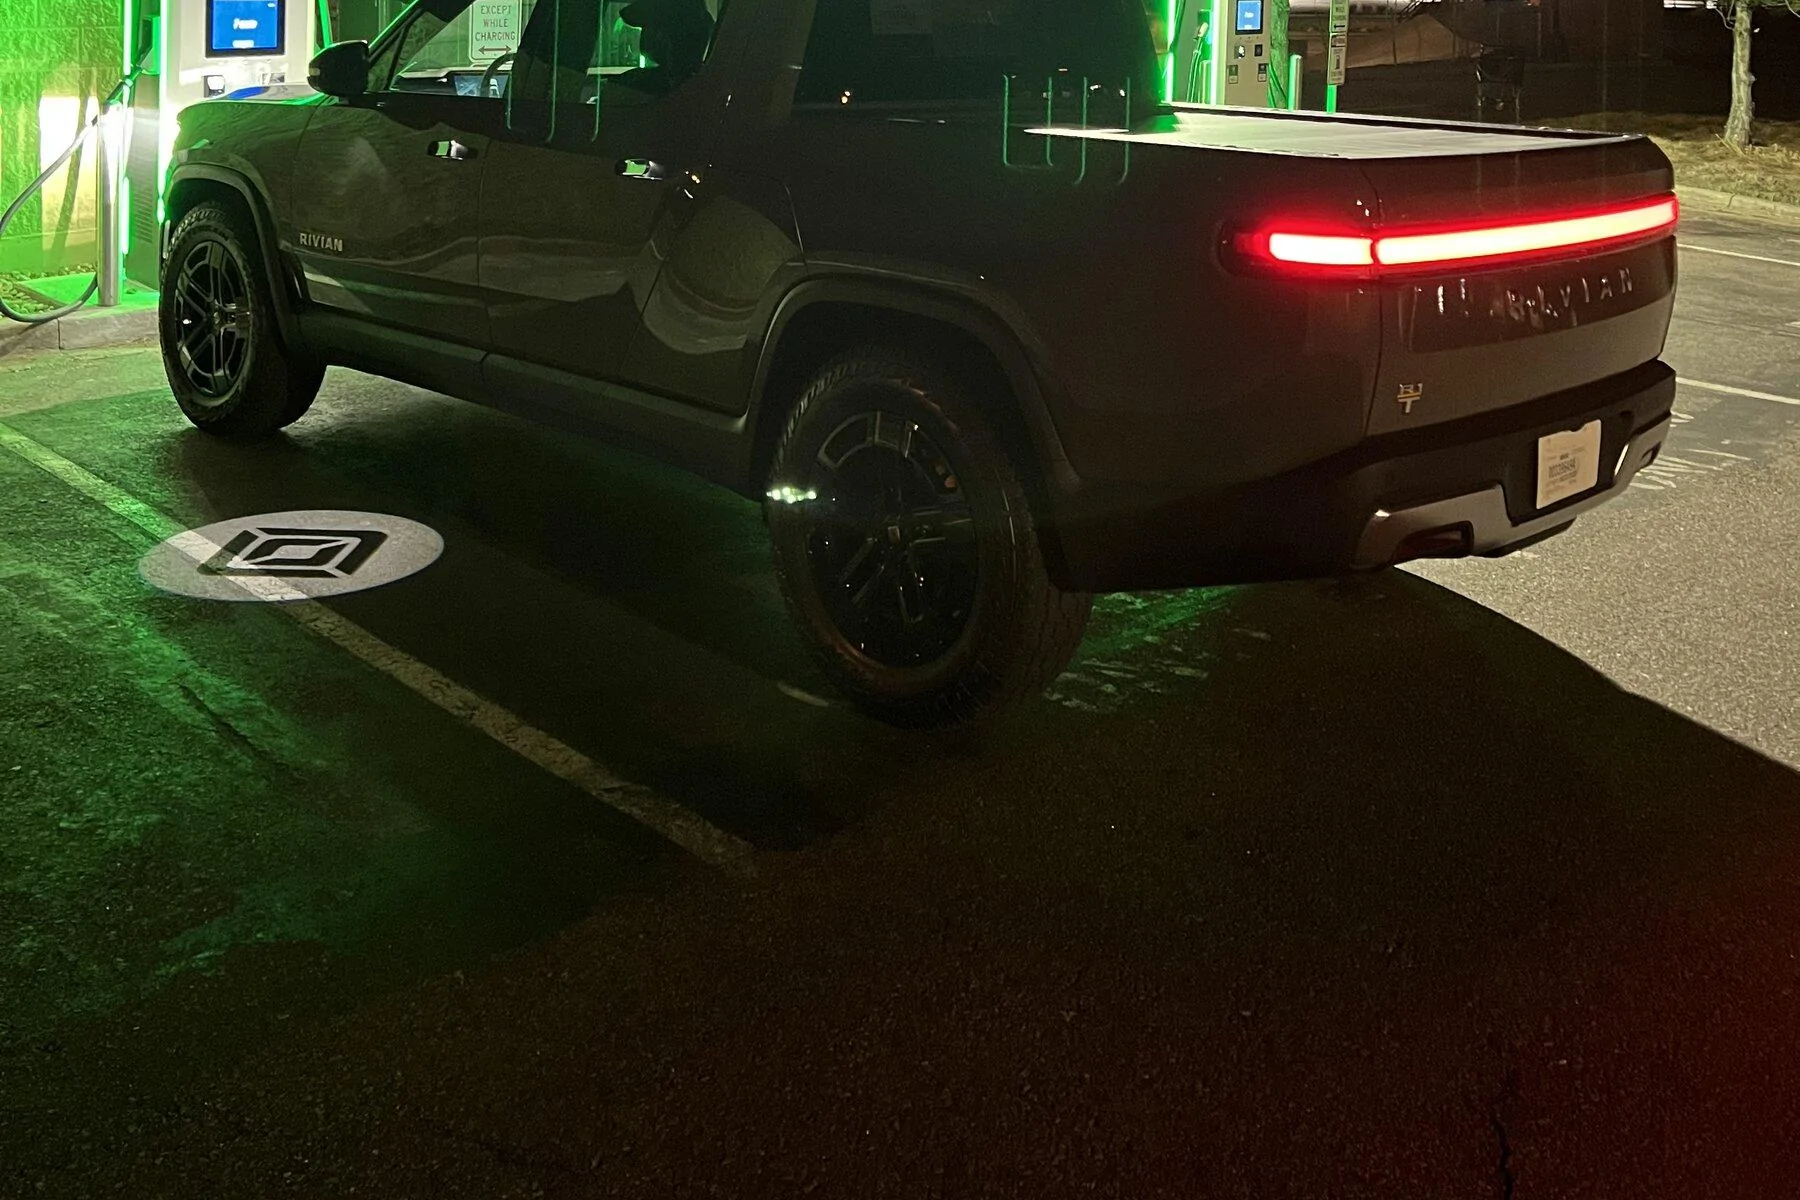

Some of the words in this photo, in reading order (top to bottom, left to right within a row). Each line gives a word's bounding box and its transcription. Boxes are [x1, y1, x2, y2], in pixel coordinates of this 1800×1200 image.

[480, 5, 512, 15] EXCEPT
[483, 18, 509, 28] WHILE
[475, 31, 516, 41] CHARGING
[299, 232, 343, 251] RIVIAN
